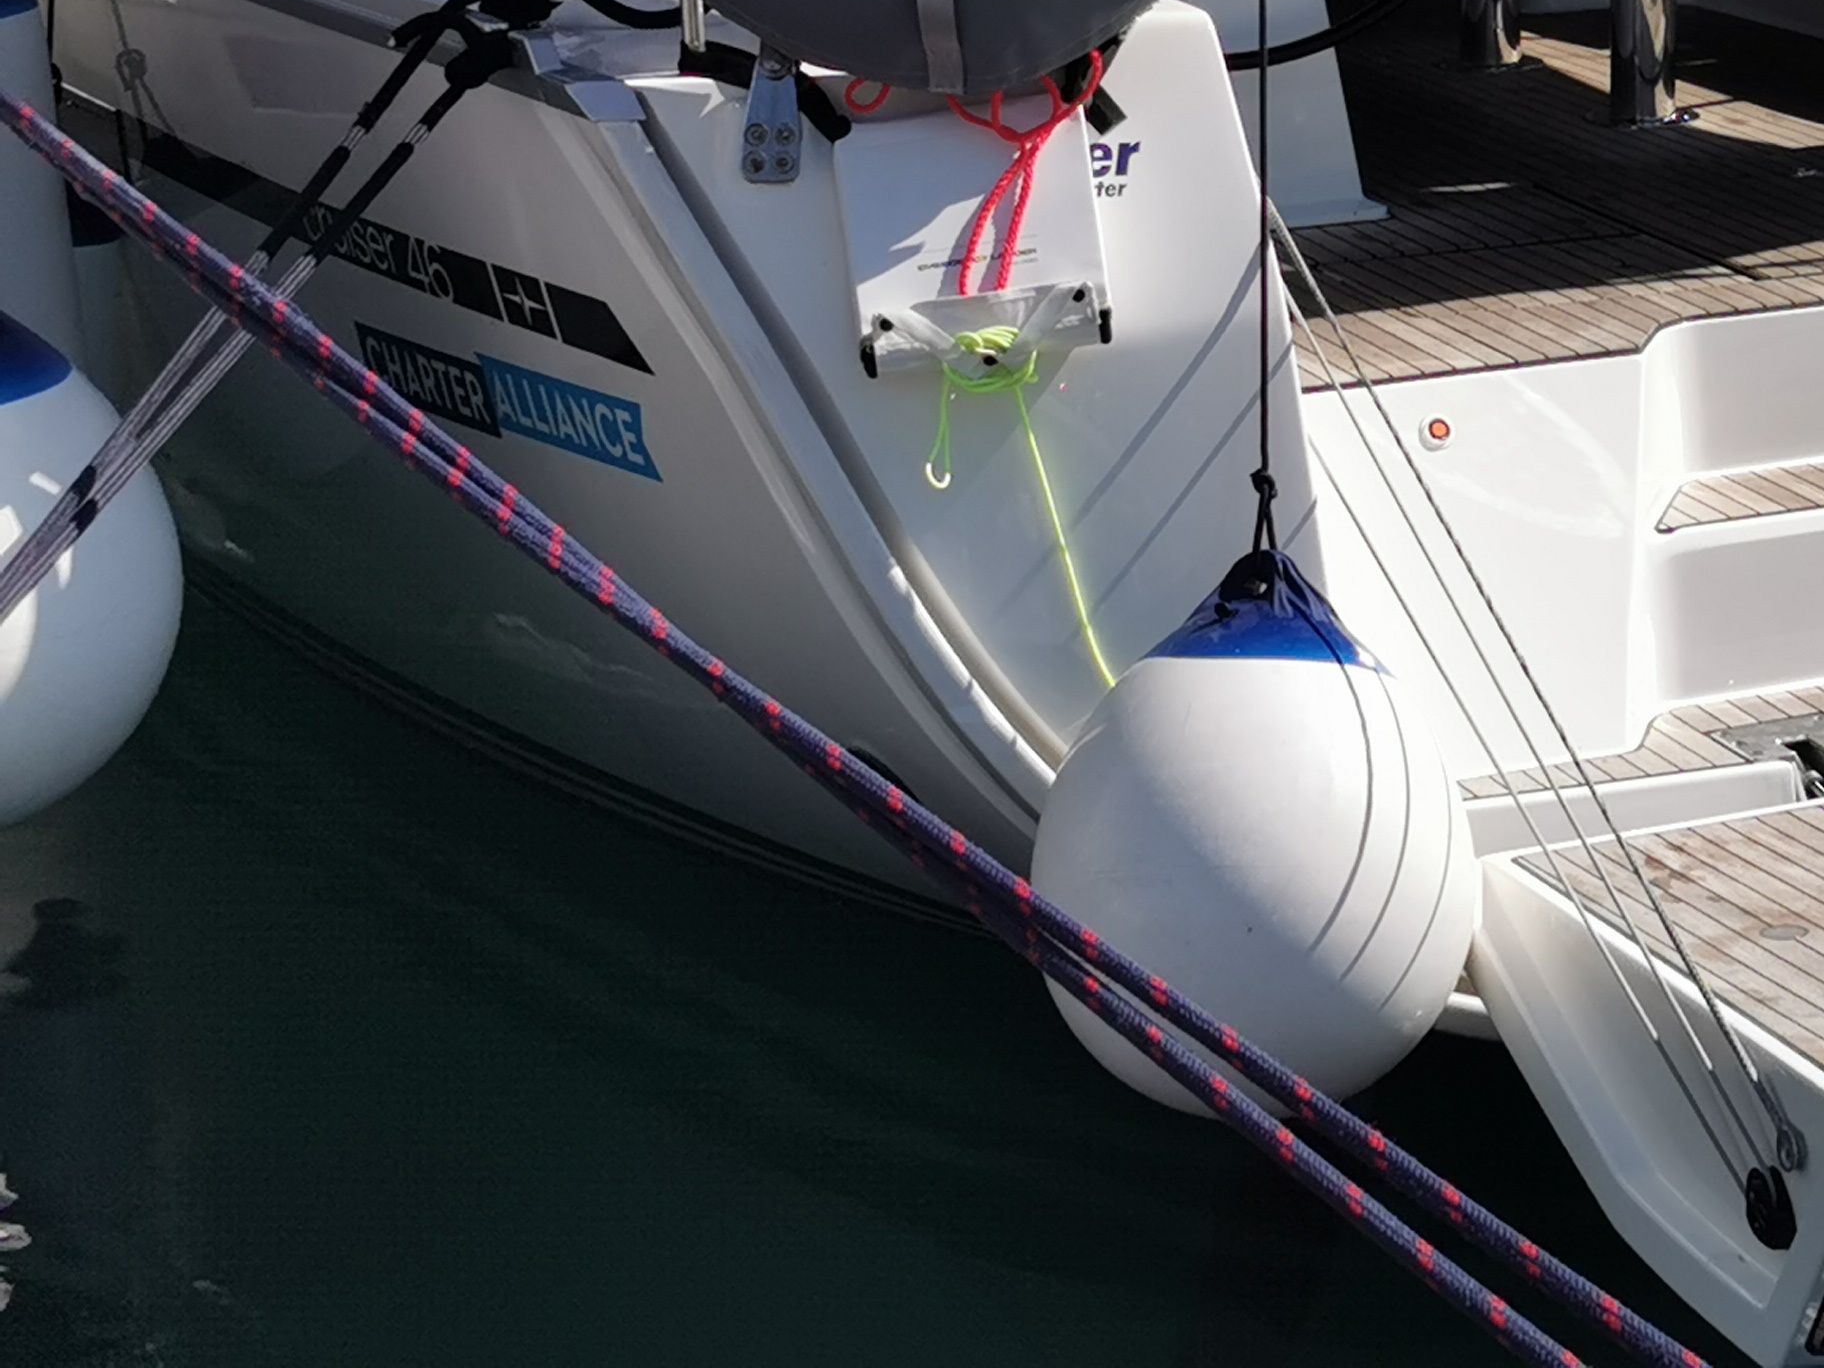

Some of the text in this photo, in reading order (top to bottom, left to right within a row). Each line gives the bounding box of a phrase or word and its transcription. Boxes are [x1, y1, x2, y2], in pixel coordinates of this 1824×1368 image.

[407, 235, 455, 303] 46
[364, 336, 646, 467] CHARTER ALLIANCE
